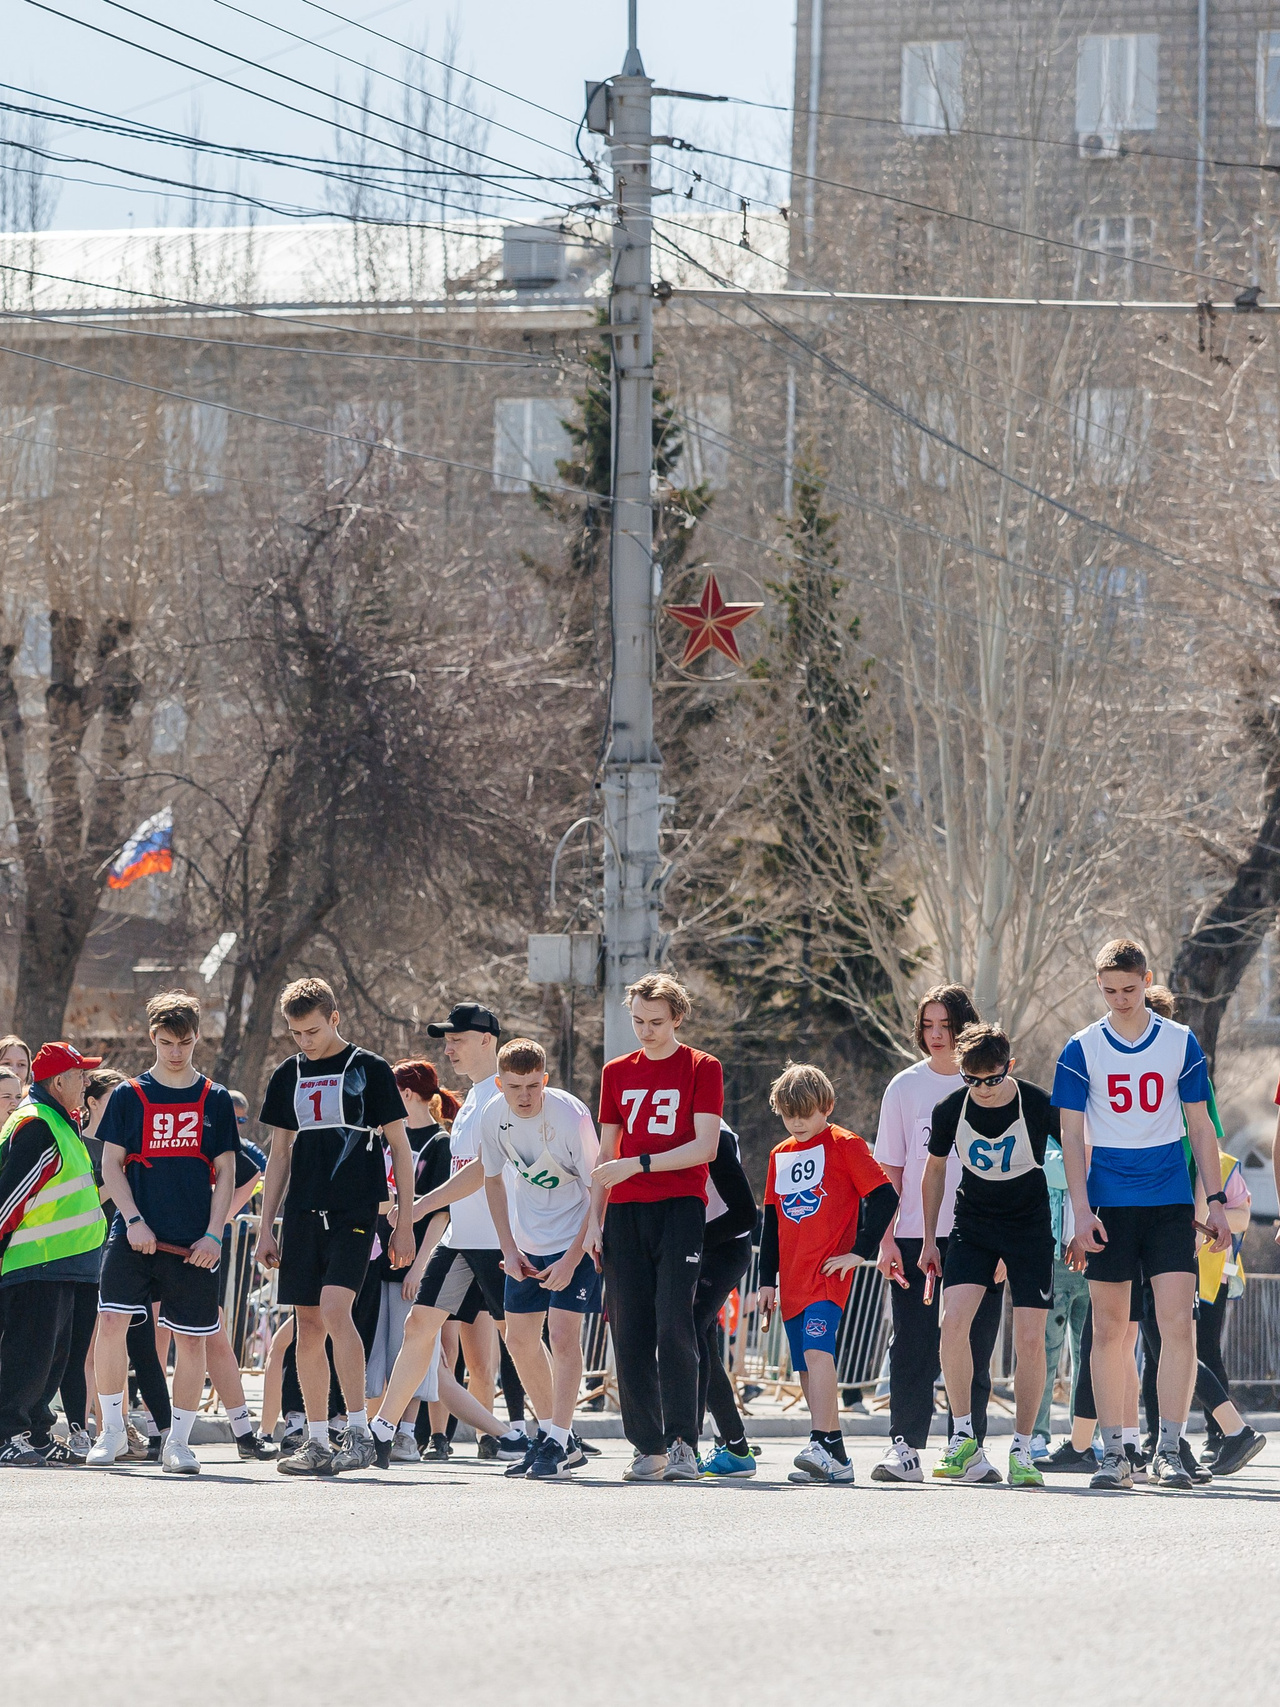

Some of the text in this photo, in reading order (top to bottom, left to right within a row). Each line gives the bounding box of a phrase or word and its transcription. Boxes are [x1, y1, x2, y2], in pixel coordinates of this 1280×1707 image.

[309, 1090, 323, 1121] 1
[1107, 1071, 1164, 1114] 50
[153, 1111, 198, 1139] 92
[621, 1089, 680, 1136] 73
[149, 1139, 198, 1149] ШКОЛА
[969, 1135, 1016, 1173] 67
[790, 1159, 816, 1184] 69
